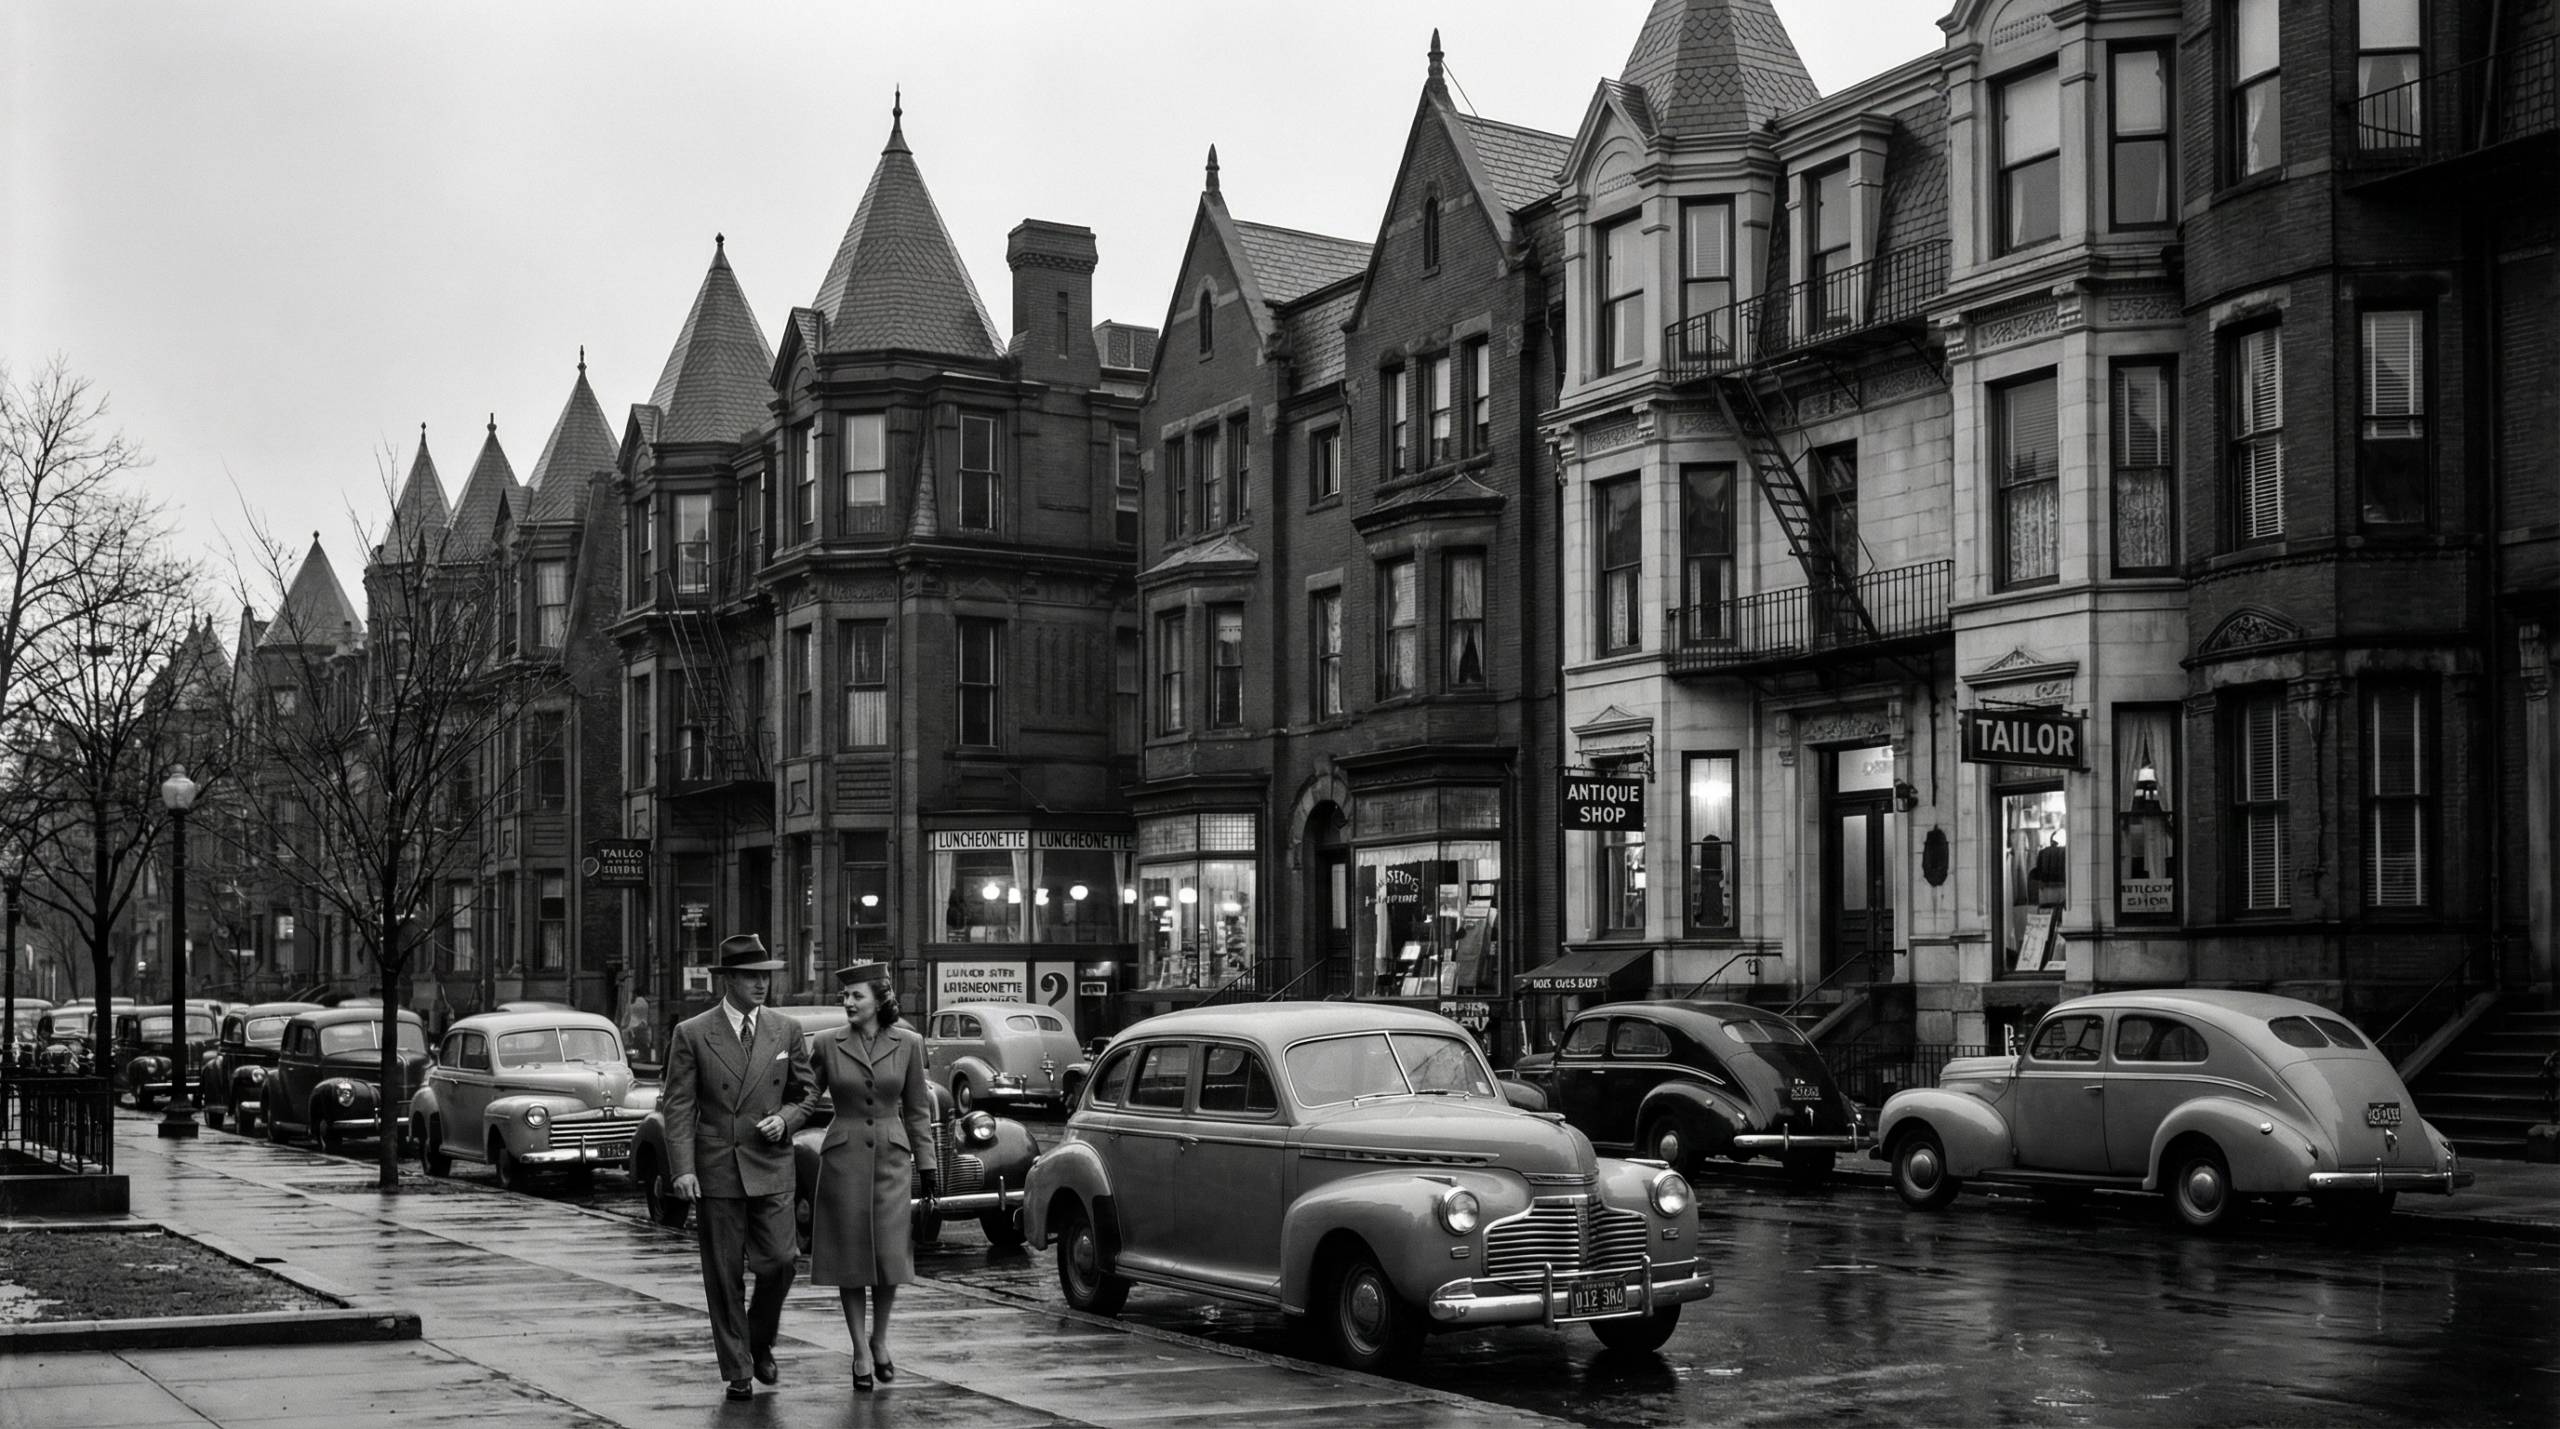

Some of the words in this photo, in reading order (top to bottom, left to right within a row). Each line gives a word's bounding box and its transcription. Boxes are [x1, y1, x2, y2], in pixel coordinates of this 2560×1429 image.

[1976, 719, 2075, 756] TAILOR
[1567, 784, 1639, 804] ANTIQUE
[1580, 806, 1626, 823] SHOP
[939, 831, 1026, 848] LUNCHEONETTE
[1039, 831, 1132, 849] LUNCHEONETTE
